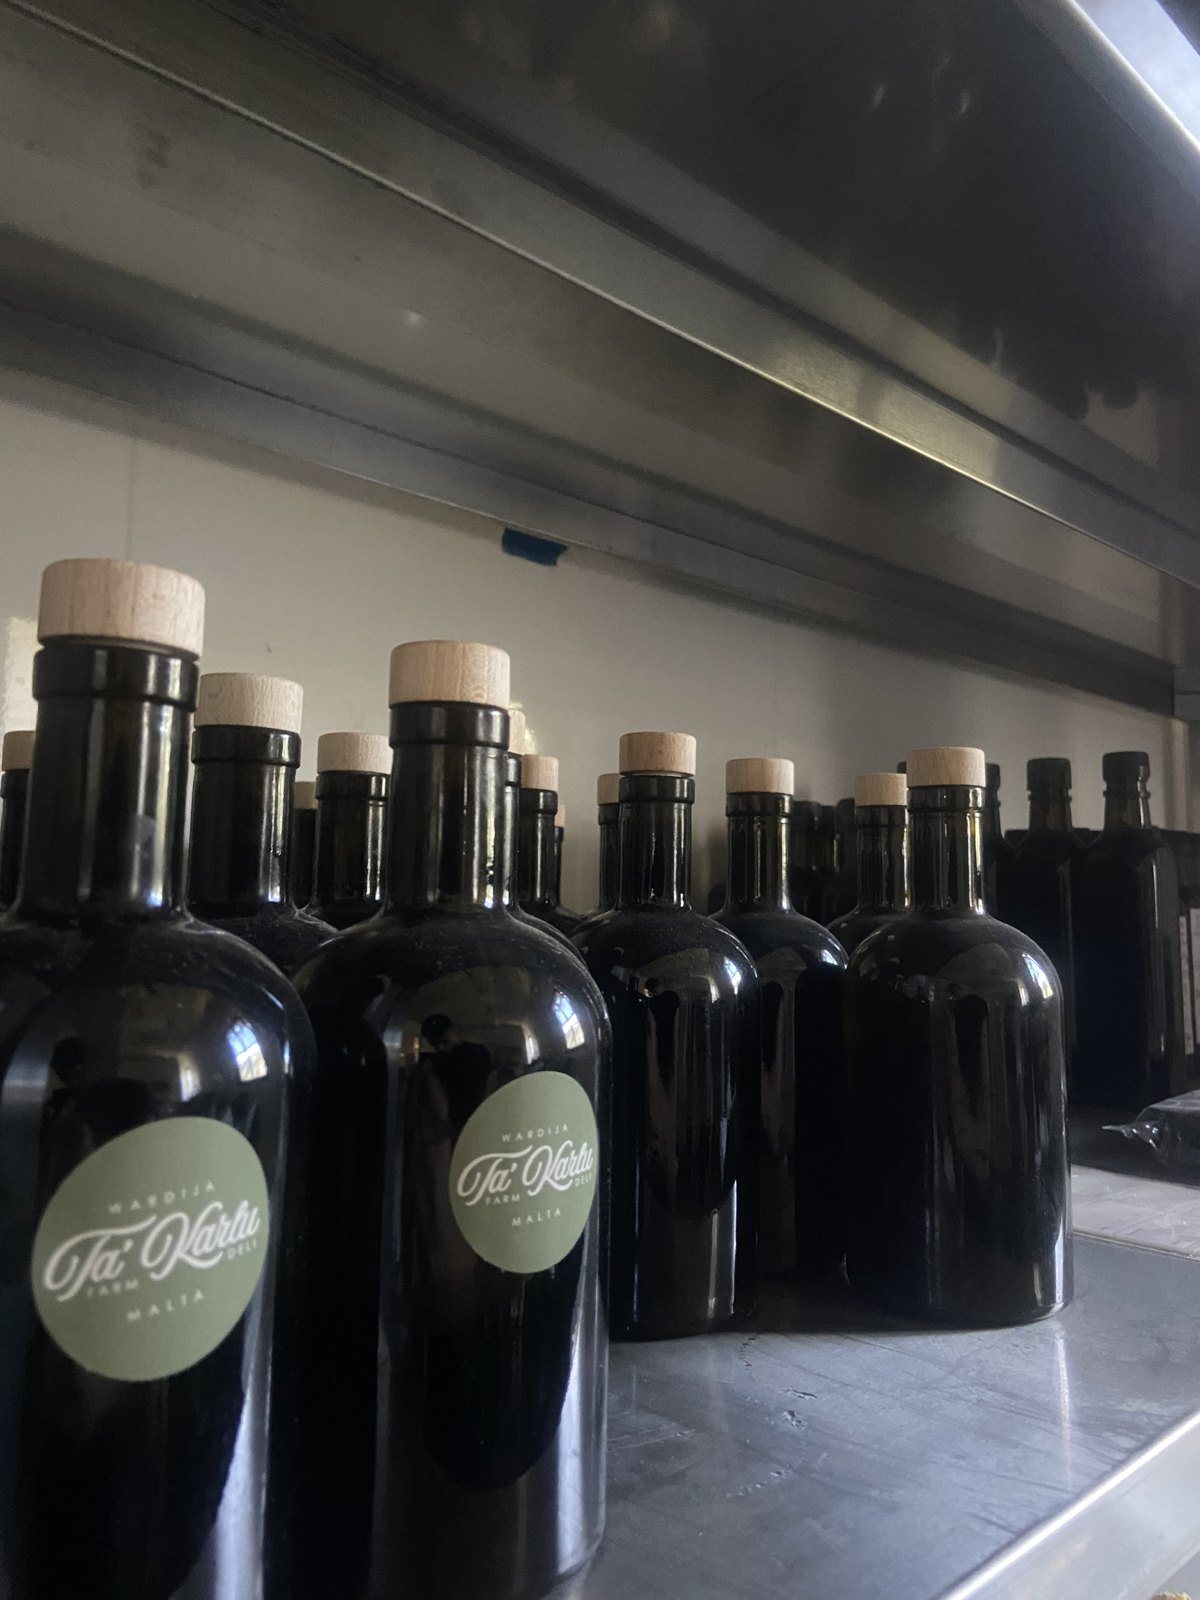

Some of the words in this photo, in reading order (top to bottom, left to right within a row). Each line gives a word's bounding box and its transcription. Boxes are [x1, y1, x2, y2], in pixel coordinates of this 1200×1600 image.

[501, 1123, 569, 1142] WARDIJA
[522, 1140, 594, 1196] Karlu
[108, 1181, 216, 1214] WARDIJA
[485, 1193, 521, 1206] FARM
[574, 1174, 593, 1187] DELI
[511, 1208, 561, 1227] MALTA
[140, 1199, 260, 1281] Karlu
[87, 1278, 139, 1298] FARM
[227, 1238, 258, 1260] DELI
[126, 1289, 205, 1322] MALTA
